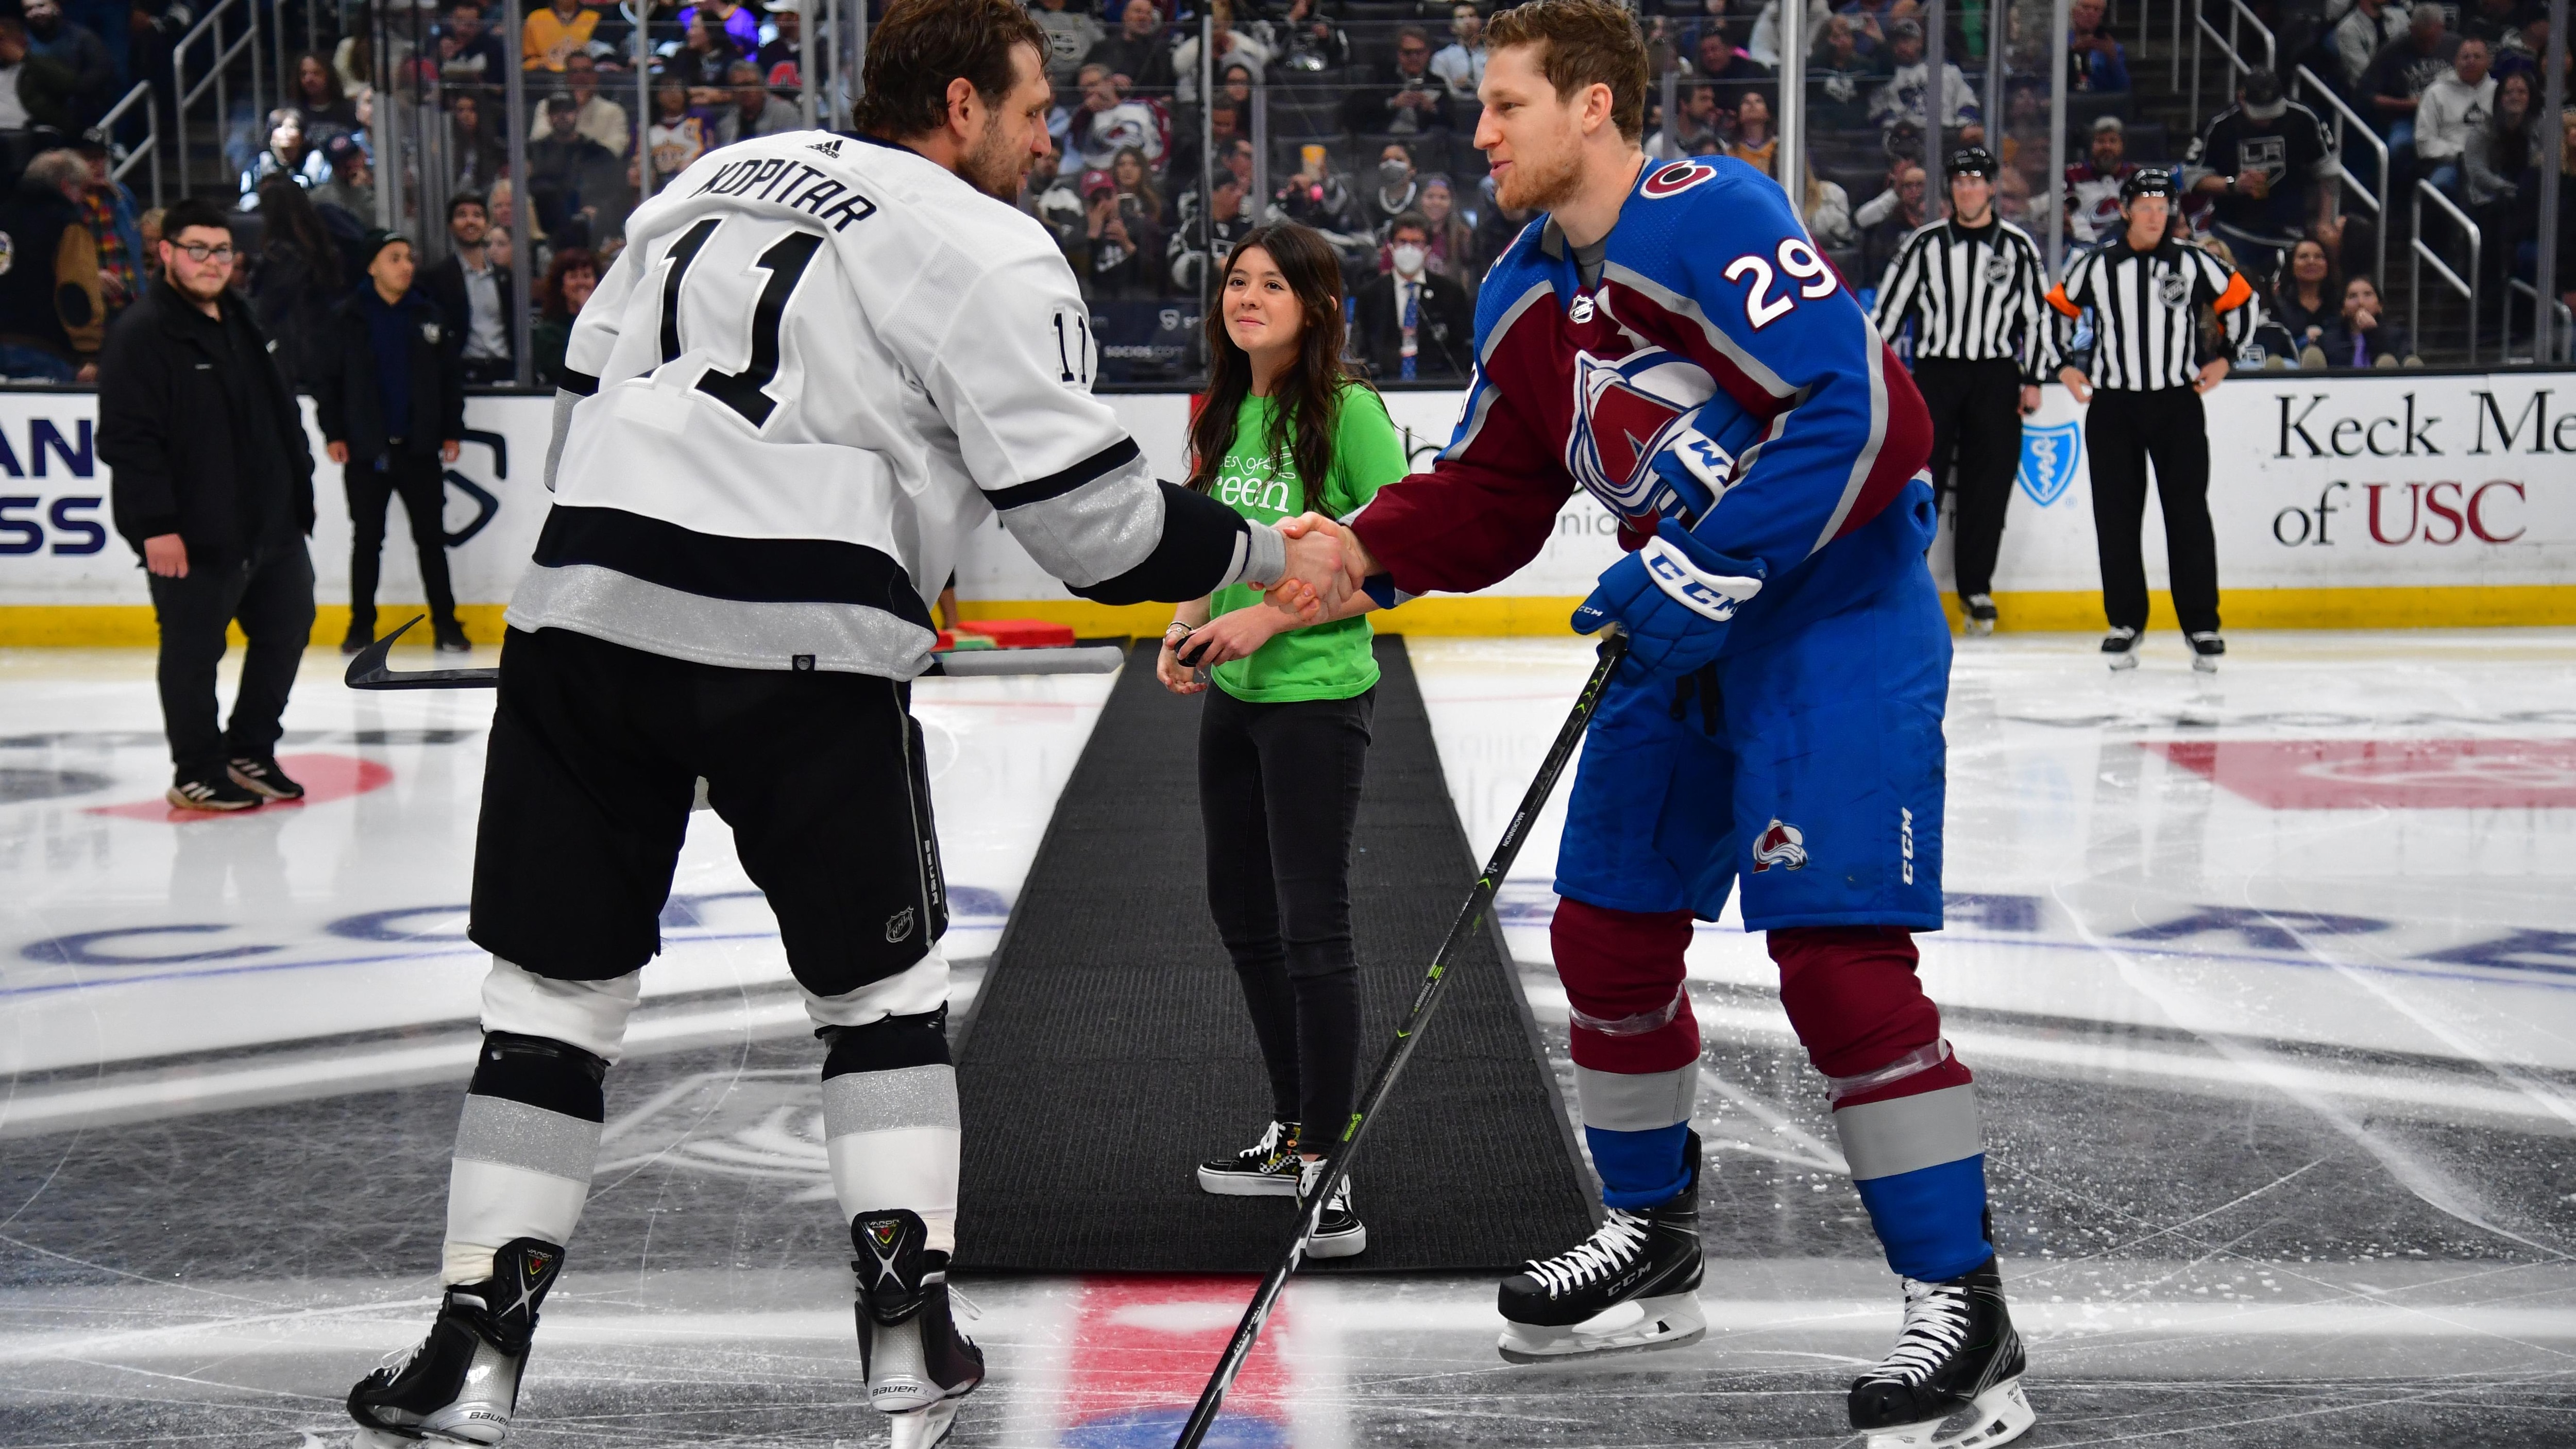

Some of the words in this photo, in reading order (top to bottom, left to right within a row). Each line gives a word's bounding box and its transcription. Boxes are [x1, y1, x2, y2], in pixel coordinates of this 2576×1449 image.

[805, 143, 840, 159] adidas
[686, 158, 877, 233] KOPITAR
[1722, 237, 1839, 331] 29
[636, 218, 825, 430] 11
[1054, 313, 1086, 383] 11
[2273, 390, 2445, 459] Keck
[2273, 481, 2349, 546] of
[2362, 480, 2526, 546] USC
[1578, 605, 1603, 617] CCM
[1650, 551, 1745, 614] CCM
[1502, 812, 1526, 847] MACKINNON
[1902, 806, 1913, 886] CCM
[892, 915, 909, 938] NHL
[527, 1248, 553, 1259] VAPOR
[1607, 1261, 1652, 1297] CCM
[872, 1386, 918, 1397] BAUER
